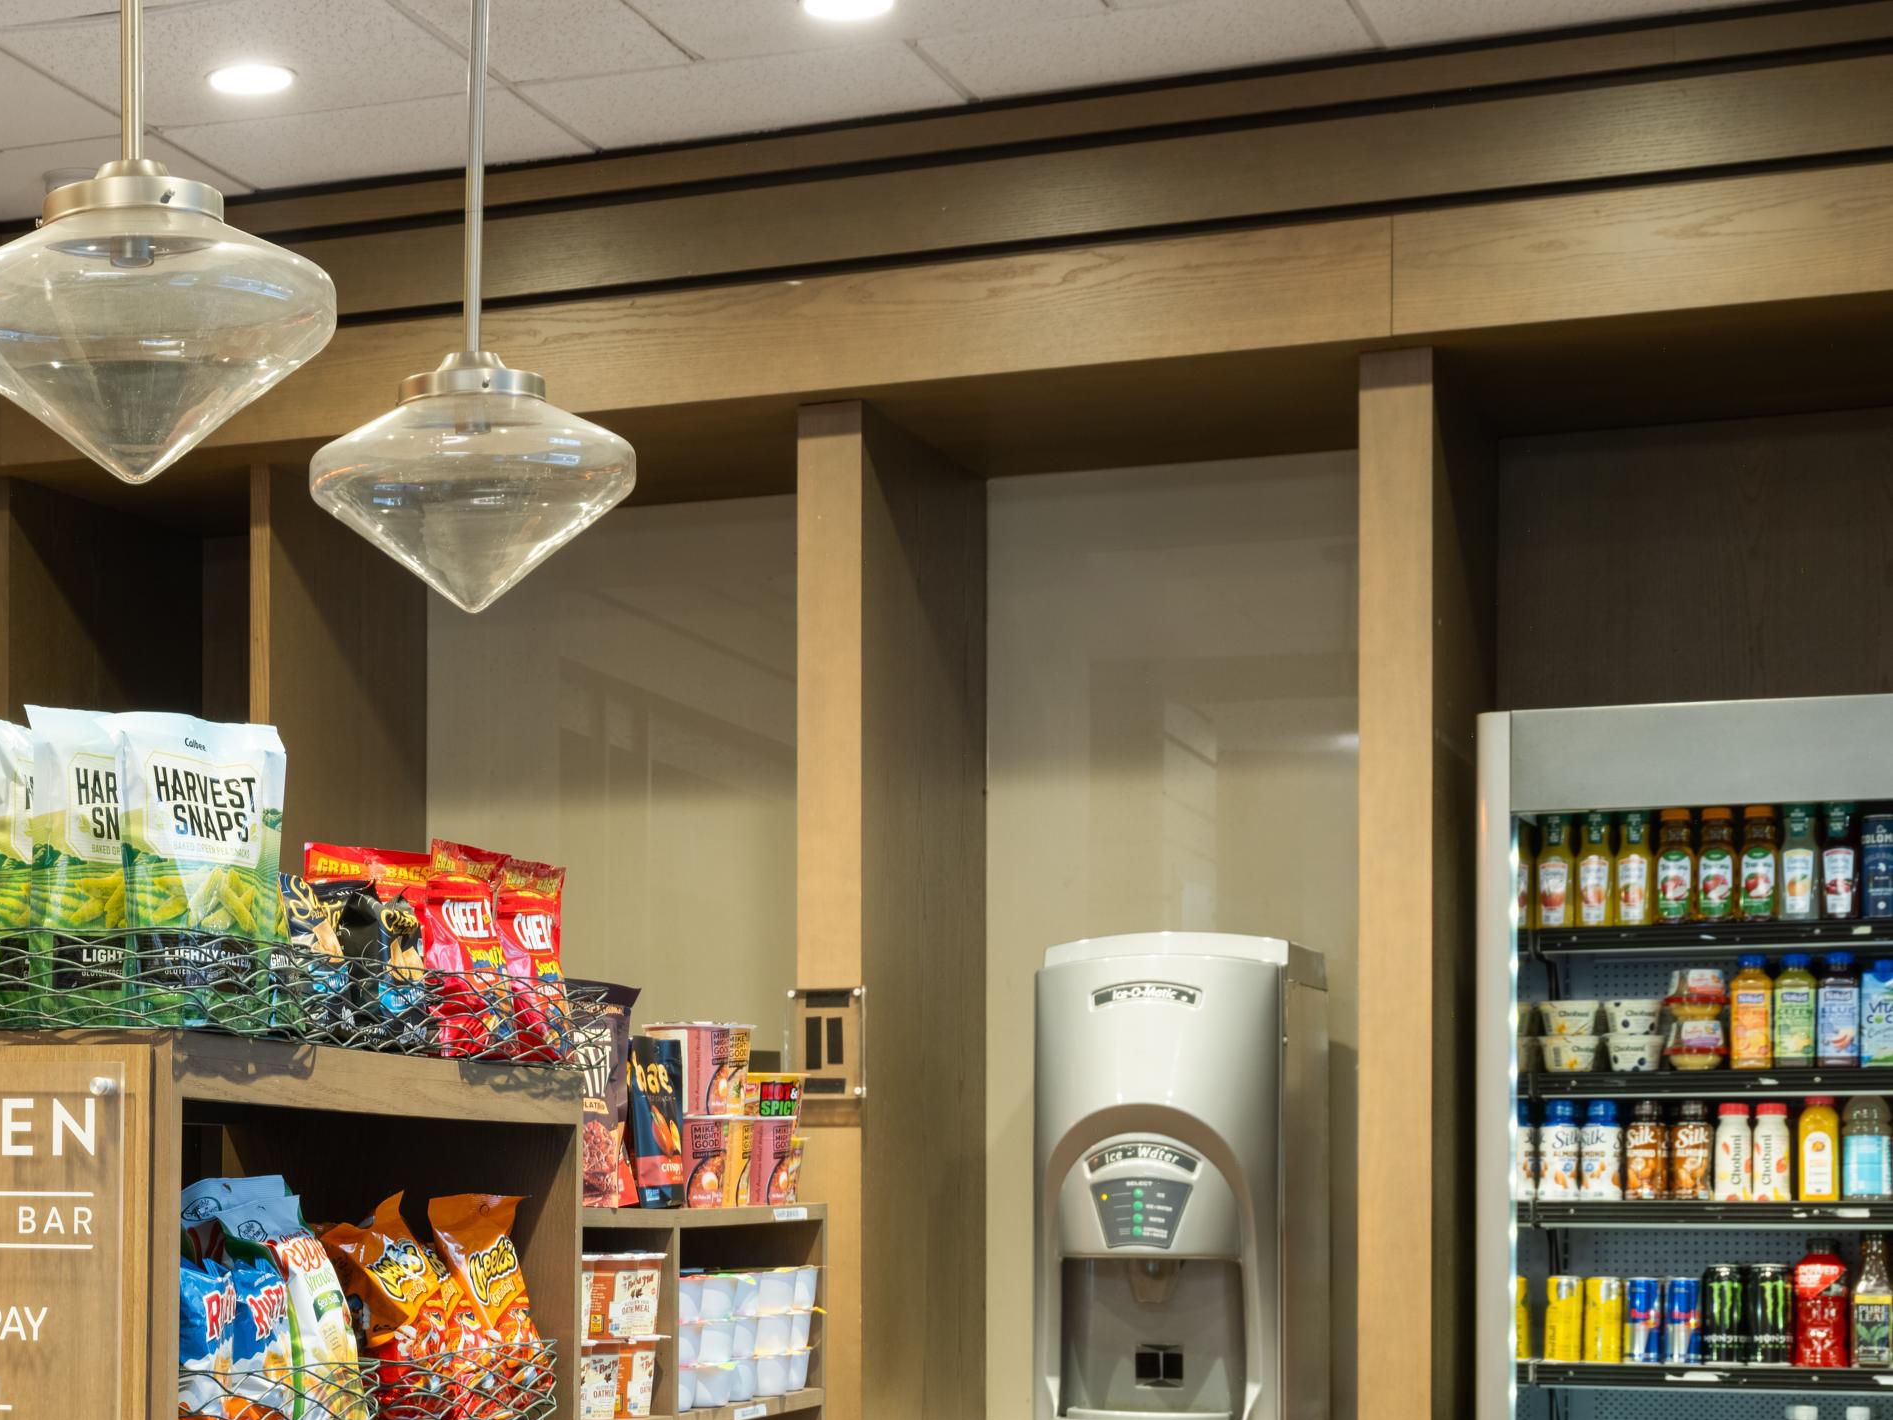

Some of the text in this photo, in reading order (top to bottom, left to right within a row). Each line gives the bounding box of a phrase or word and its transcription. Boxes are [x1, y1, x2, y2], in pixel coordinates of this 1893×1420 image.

[184, 737, 207, 752] Calbee
[153, 765, 256, 813] HARVEST
[173, 804, 249, 843] SNAPS
[317, 857, 361, 875] GRAB
[1112, 985, 1179, 999] Ice-O-Matic
[761, 1082, 791, 1100] HOT
[761, 1101, 796, 1116] SPICY
[694, 1138, 719, 1149] GOOD
[1626, 1125, 1657, 1149] Silk
[1676, 1124, 1710, 1148] Silk
[1105, 1151, 1123, 1164] Ice
[1138, 1145, 1180, 1164] Water
[1731, 1134, 1743, 1186] Chobani
[1762, 1134, 1773, 1187] Chobani
[18, 1206, 93, 1236] BAR
